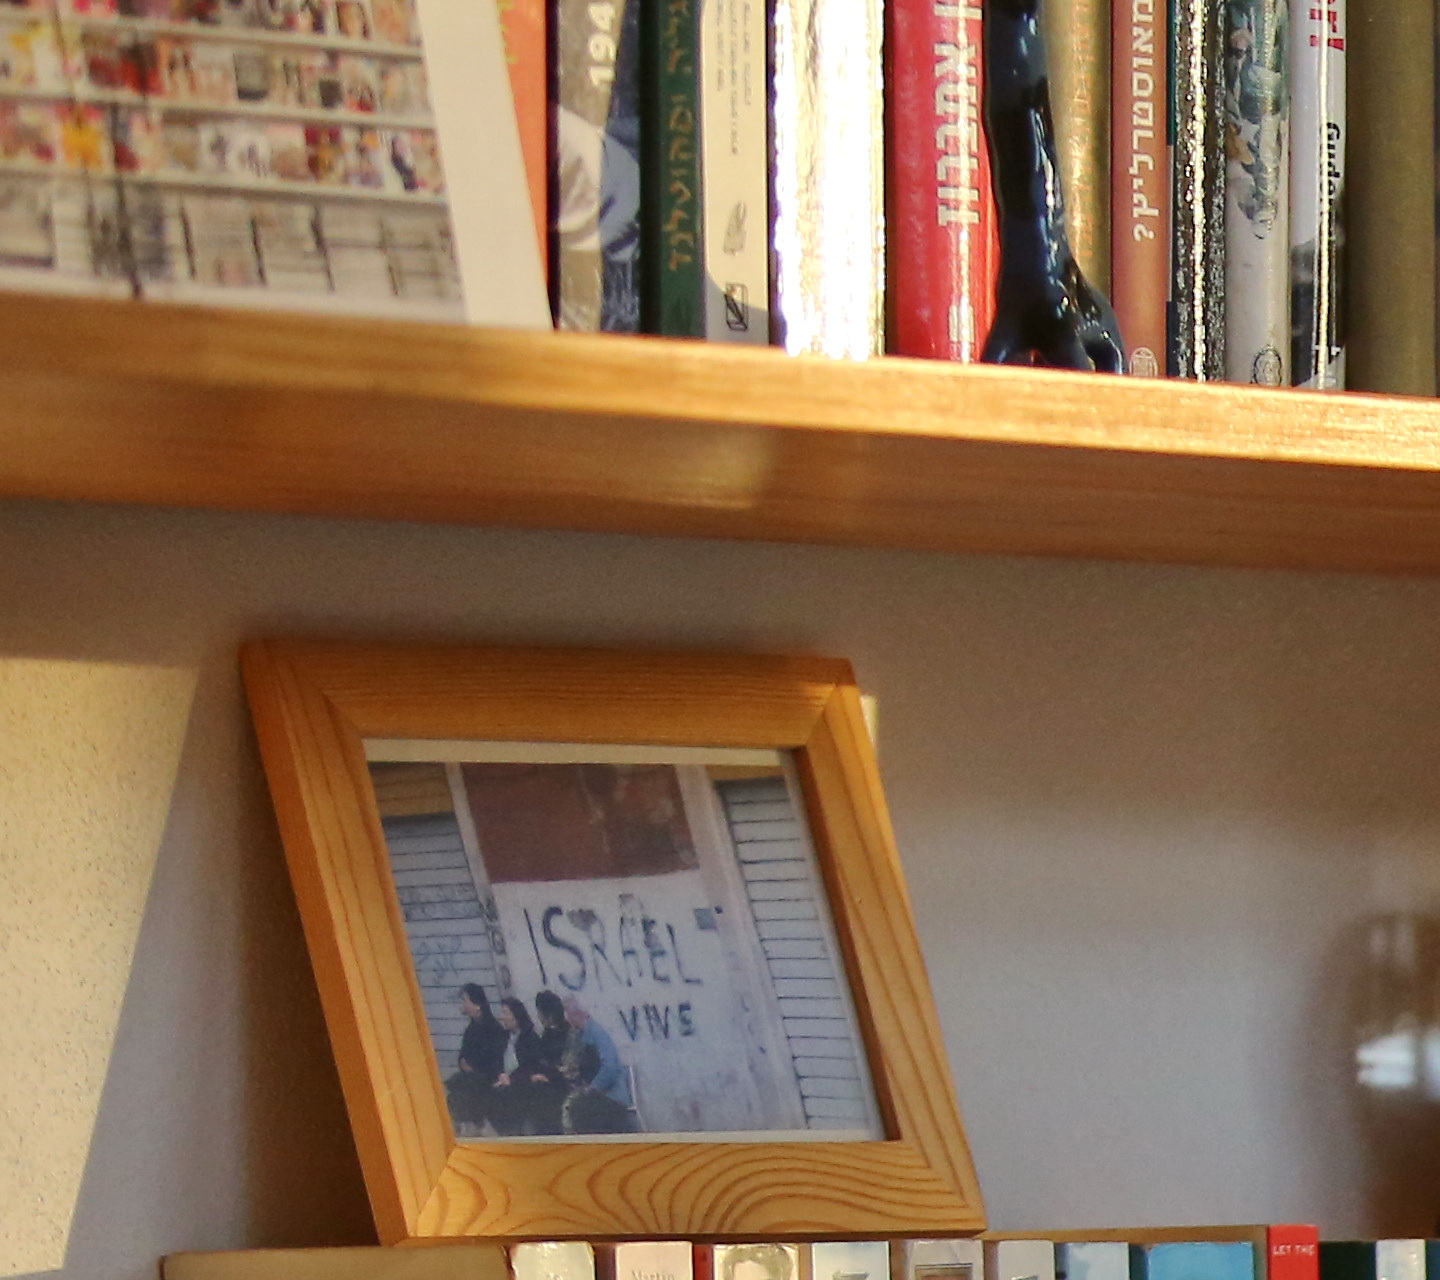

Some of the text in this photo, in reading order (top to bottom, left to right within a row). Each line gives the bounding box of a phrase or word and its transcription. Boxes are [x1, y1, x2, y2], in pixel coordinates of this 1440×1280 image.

[934, 41, 981, 228] אמברוז
[523, 902, 703, 992] ISRAEL
[1272, 1244, 1315, 1256] LET THE
